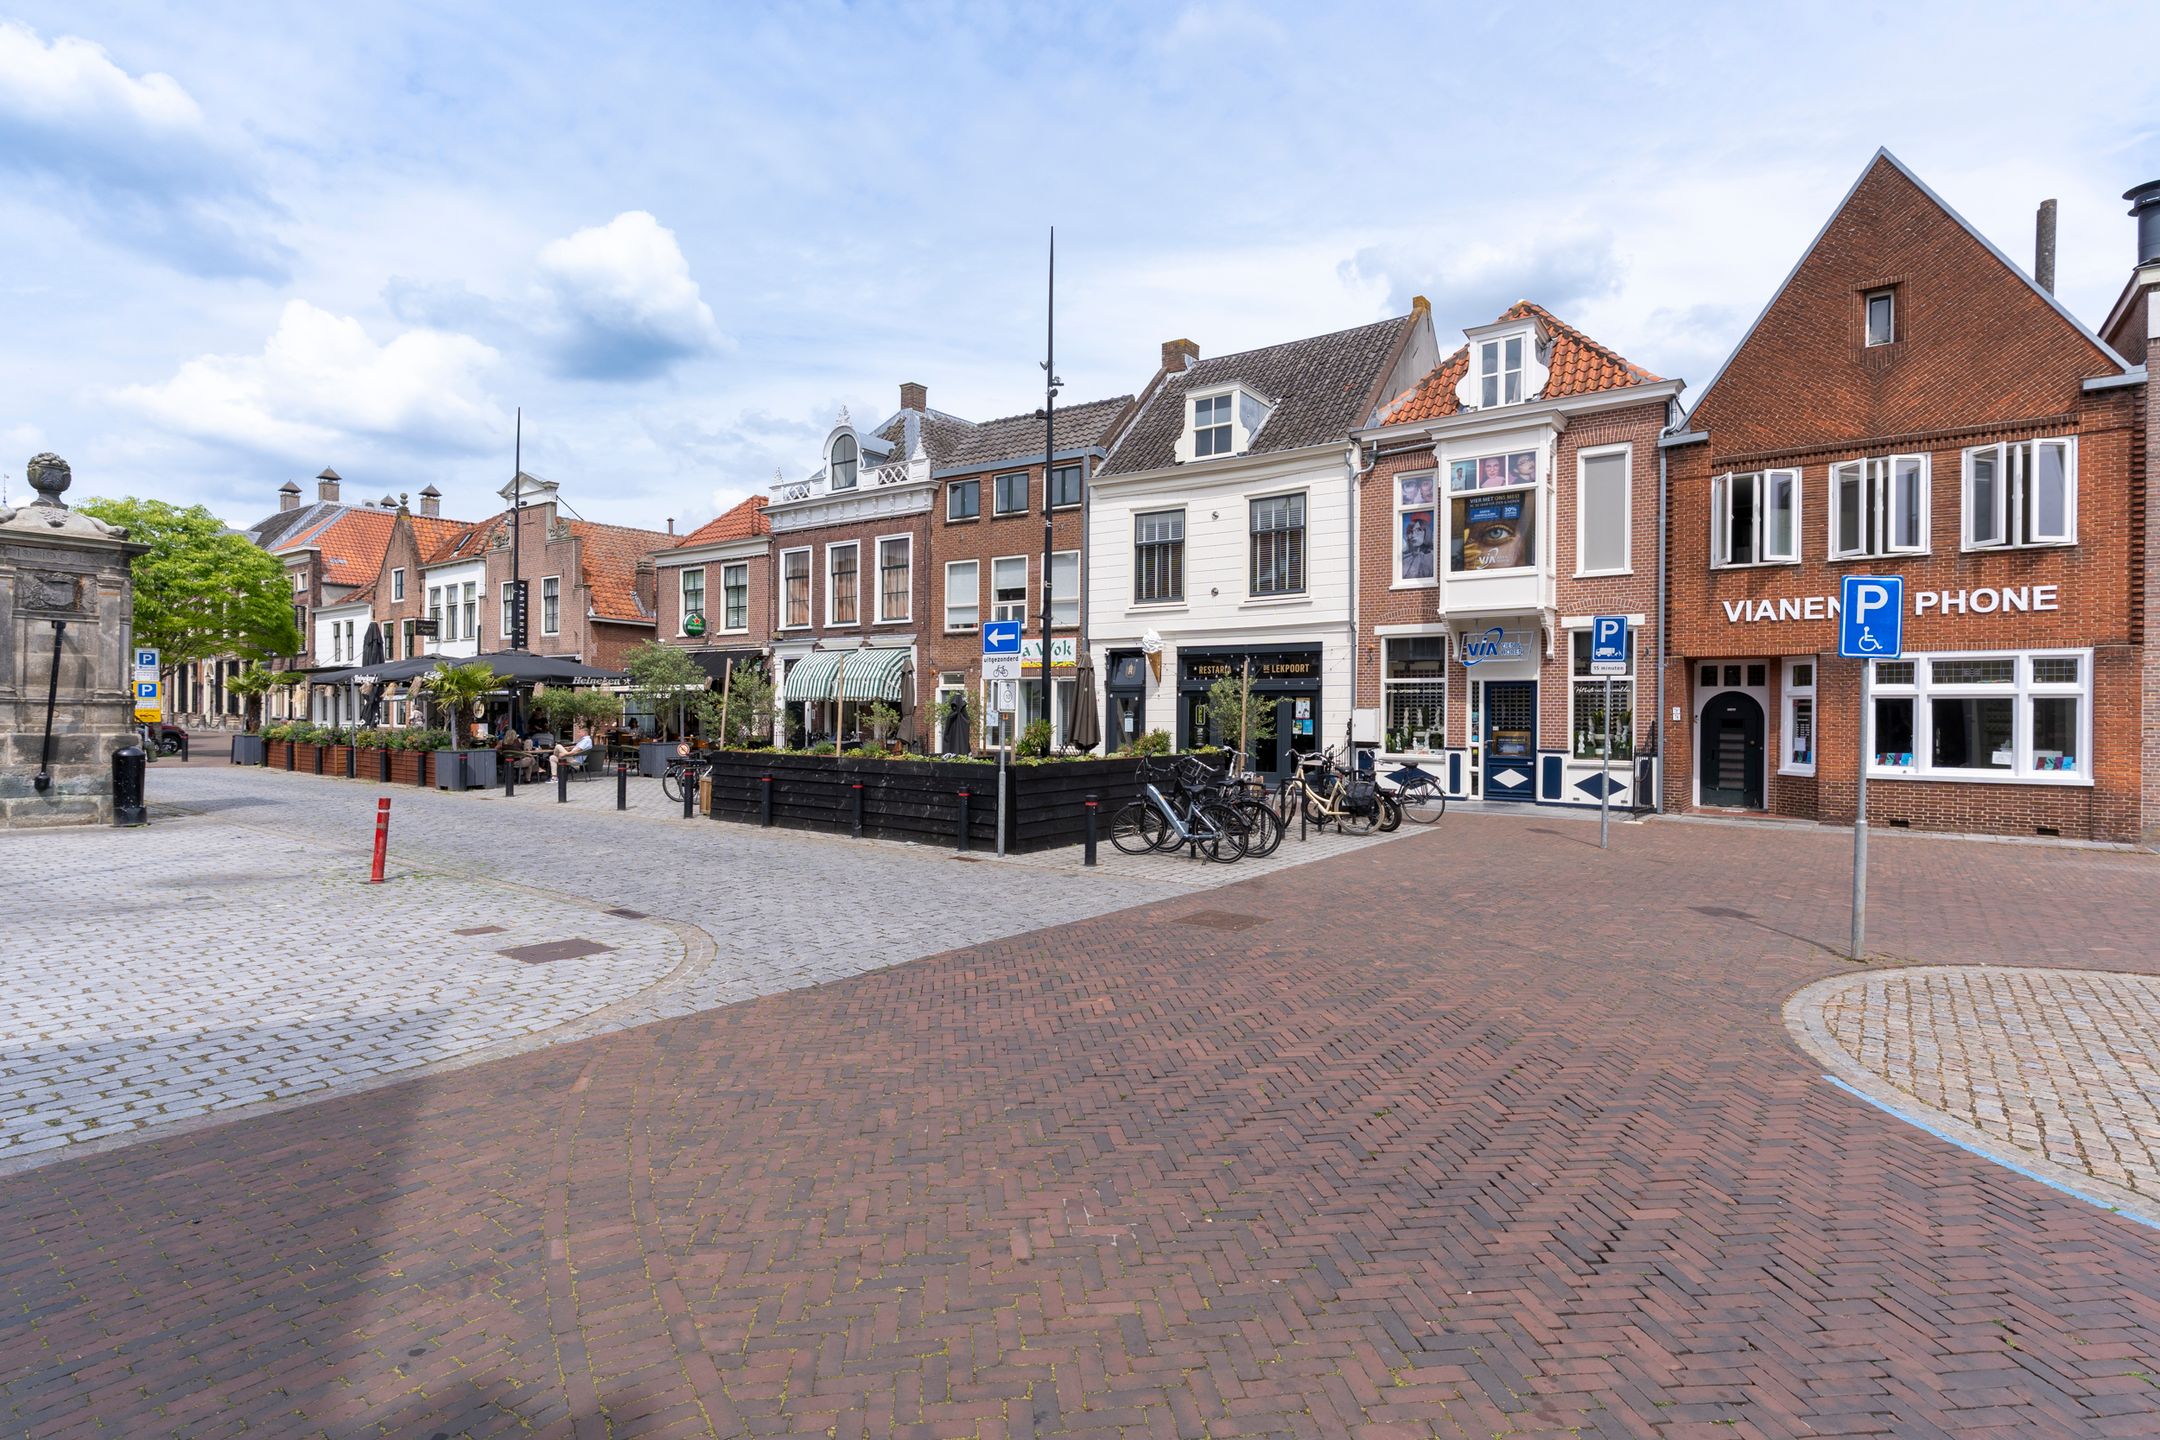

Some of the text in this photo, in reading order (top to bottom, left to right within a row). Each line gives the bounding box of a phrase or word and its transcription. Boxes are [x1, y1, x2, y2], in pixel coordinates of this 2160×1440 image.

[1722, 585, 2059, 623] VIANEN PHONE
[1856, 584, 1889, 625] P
[1600, 620, 1619, 643] P
[142, 653, 153, 664] P
[984, 656, 1019, 664] uitgezonderd
[1271, 663, 1310, 673] LEKPOORT
[572, 676, 621, 685] Heineken
[141, 684, 153, 697] P
